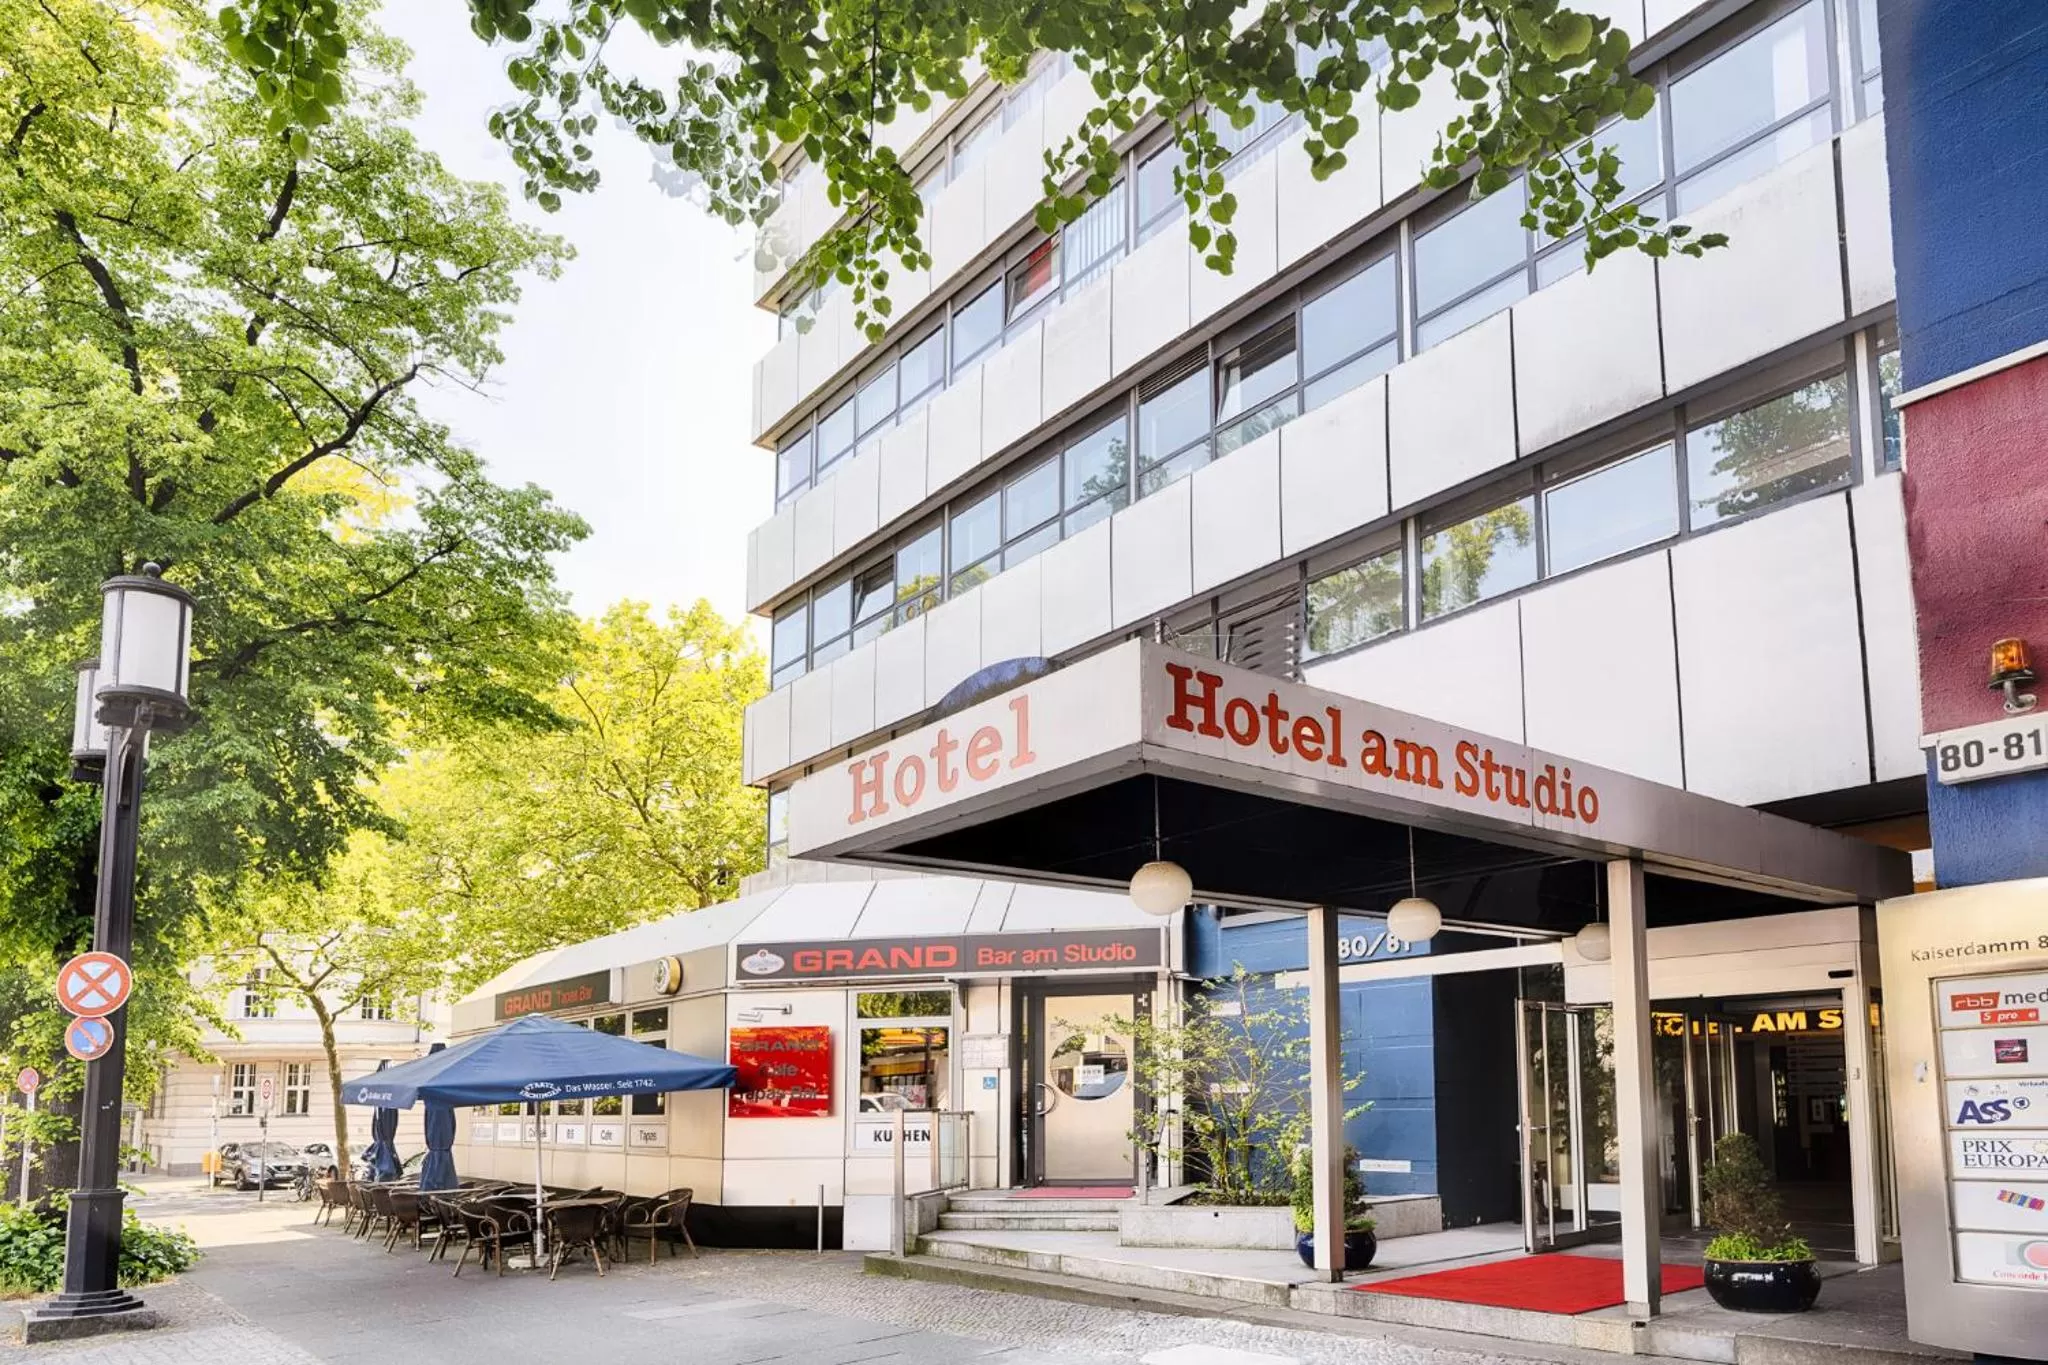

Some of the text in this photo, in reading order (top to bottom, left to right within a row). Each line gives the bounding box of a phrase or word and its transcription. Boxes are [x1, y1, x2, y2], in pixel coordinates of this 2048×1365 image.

[1165, 662, 1599, 824] Hotel am Studio
[1940, 729, 2042, 772] 80-81
[848, 694, 1036, 825] Hotel
[792, 945, 958, 973] GRAND
[977, 947, 1016, 966] Bar
[1022, 948, 1058, 964] am
[1063, 943, 1137, 963] Studio
[1911, 940, 2029, 962] Kaiserdamm
[504, 988, 552, 1015] GRAND
[1955, 997, 1994, 1008] rbb
[1751, 1012, 1807, 1032] AM
[565, 1084, 581, 1093] Das
[583, 1082, 614, 1091] Wasser.
[635, 1079, 656, 1087] 1742.
[1957, 1099, 2012, 1124] ASS
[873, 1130, 930, 1141] KUHEN
[1963, 1140, 2012, 1153] PRIX
[1963, 1154, 2048, 1167] EUROPA
